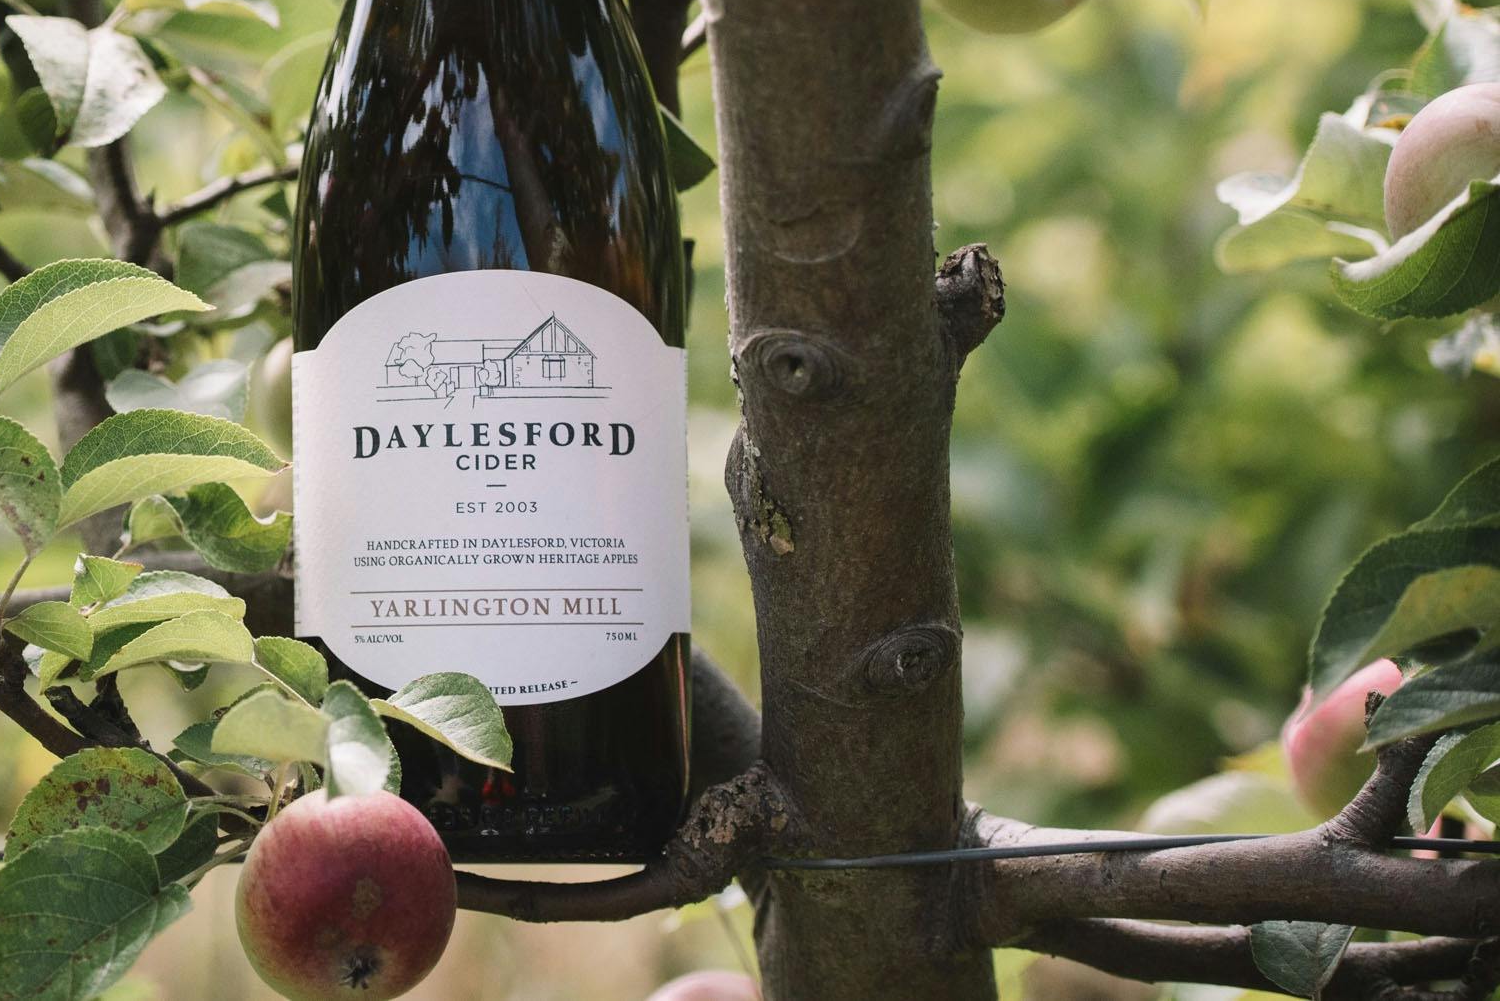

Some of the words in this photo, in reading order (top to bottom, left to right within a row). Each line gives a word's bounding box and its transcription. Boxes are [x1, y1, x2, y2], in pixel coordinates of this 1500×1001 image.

[352, 422, 636, 459] DAYLESFORD
[456, 454, 537, 471] CIDER
[456, 502, 487, 514] EST
[495, 501, 538, 513] 2003
[367, 539, 459, 551] HANDCRAFTED
[463, 538, 478, 549] IN
[481, 538, 567, 549] DAYLESFORD,
[570, 538, 626, 549] VICTORIA
[354, 556, 386, 567] USING
[389, 554, 480, 566] ORGANICALLY
[483, 554, 535, 565] GROWN
[538, 553, 600, 564] HERITAGE
[602, 553, 639, 564] APPLES
[370, 598, 551, 618] YARLINGTON
[562, 598, 622, 616] MILL
[354, 634, 366, 644] 5%
[366, 634, 404, 644] ALC/VOL
[605, 631, 638, 642] 750ML
[519, 679, 569, 695] RELEASE
